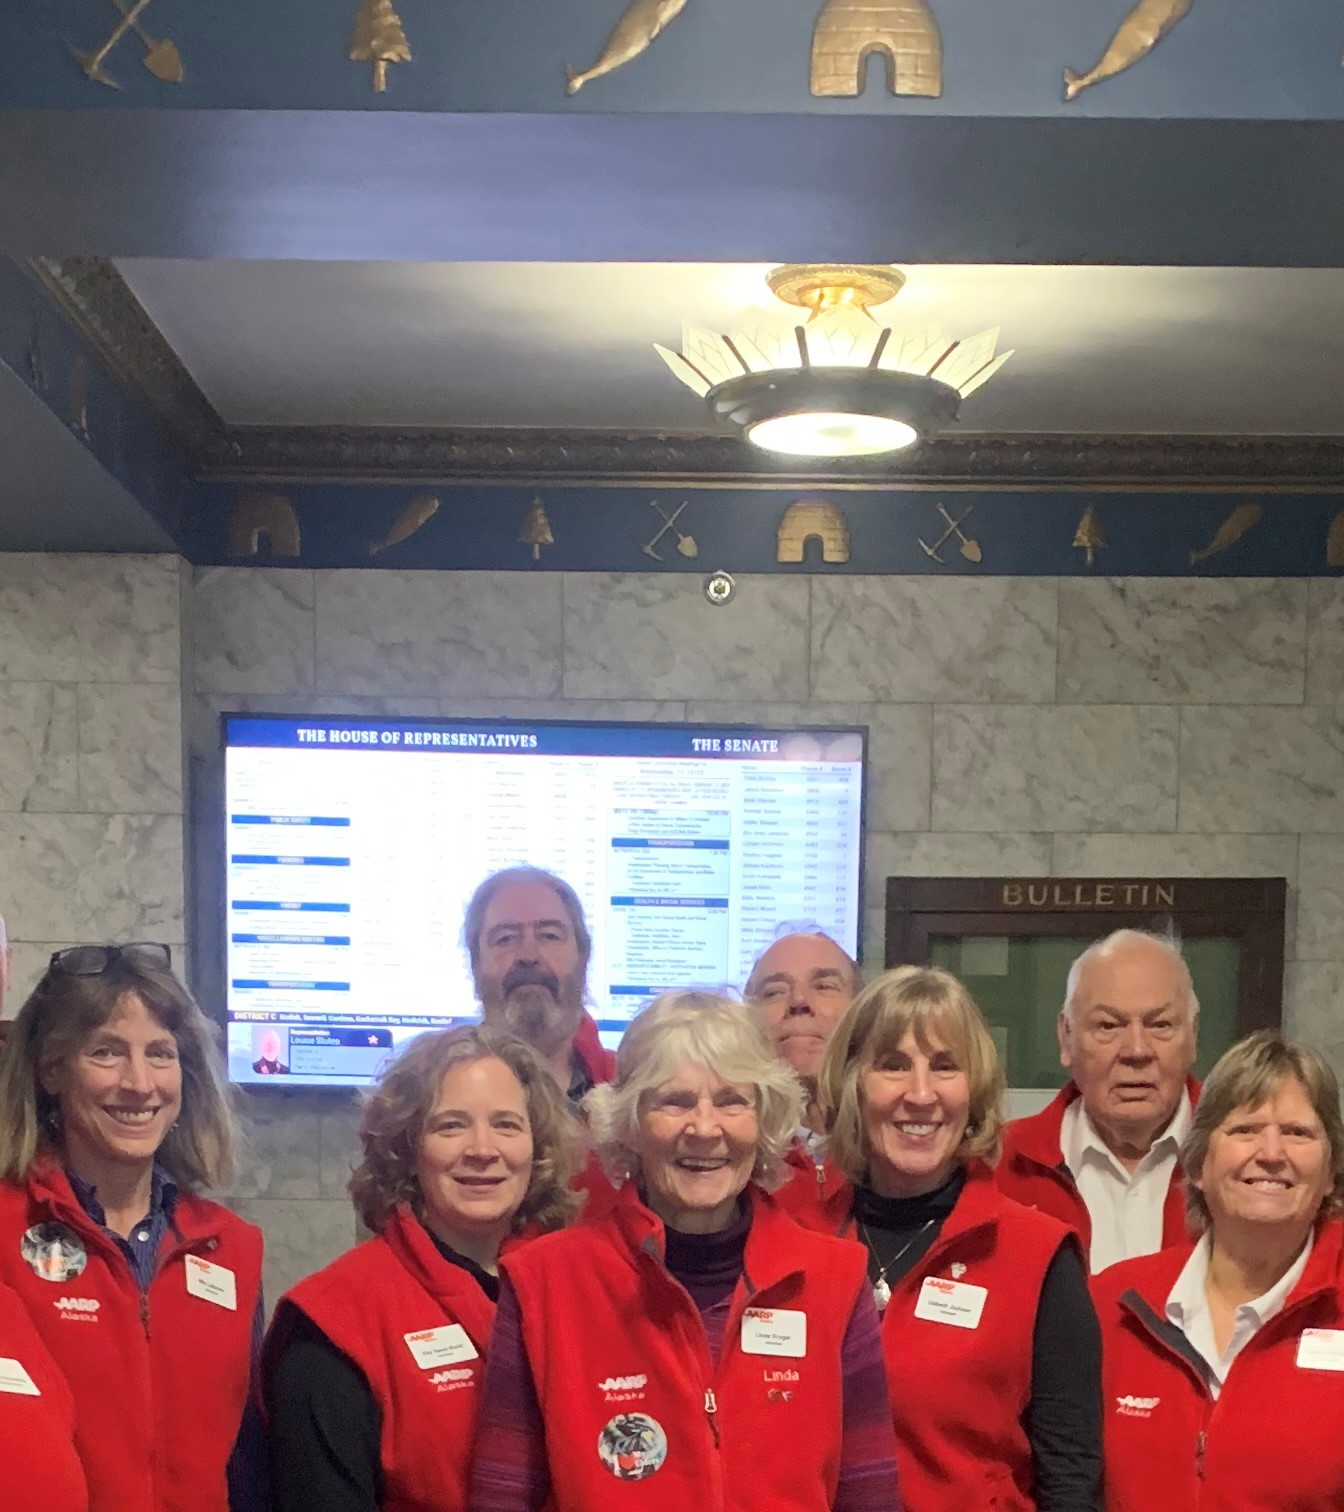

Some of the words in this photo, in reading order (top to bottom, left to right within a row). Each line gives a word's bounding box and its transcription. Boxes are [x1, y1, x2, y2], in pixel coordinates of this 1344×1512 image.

[297, 728, 327, 742] THE
[329, 729, 379, 744] HOUSE
[381, 731, 401, 745] OF
[403, 731, 538, 748] REPRESENTATIVES
[691, 738, 721, 752] THE
[723, 738, 779, 753] SENATE
[1002, 884, 1175, 906] BULLETIN
[234, 1011, 269, 1021] DISTRICT
[763, 1368, 800, 1382] Linda
